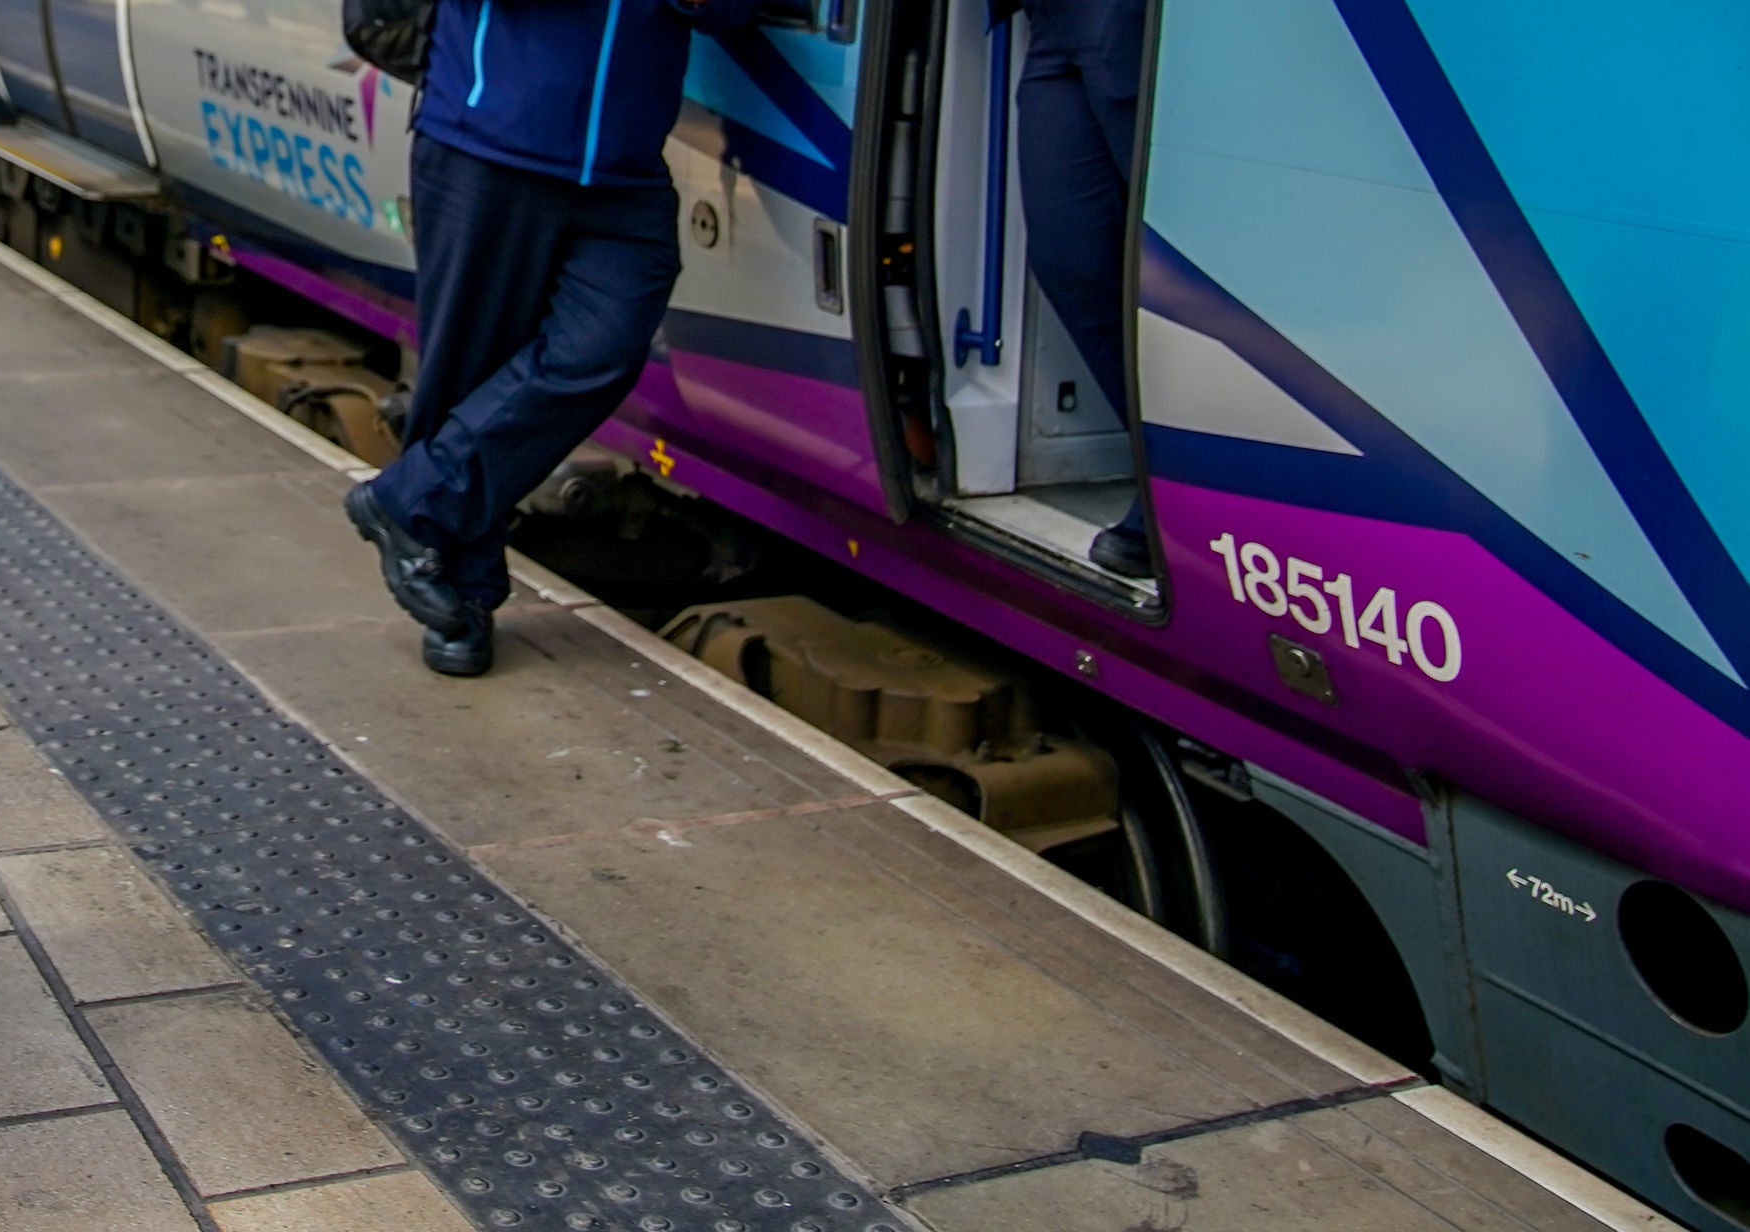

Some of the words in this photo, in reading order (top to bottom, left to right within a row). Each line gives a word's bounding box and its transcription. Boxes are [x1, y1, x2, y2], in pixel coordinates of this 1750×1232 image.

[193, 48, 359, 142] TRANSPENNINE
[199, 98, 375, 229] EXPRESS
[1209, 531, 1462, 683] 185140
[1527, 876, 1575, 916] 72m
